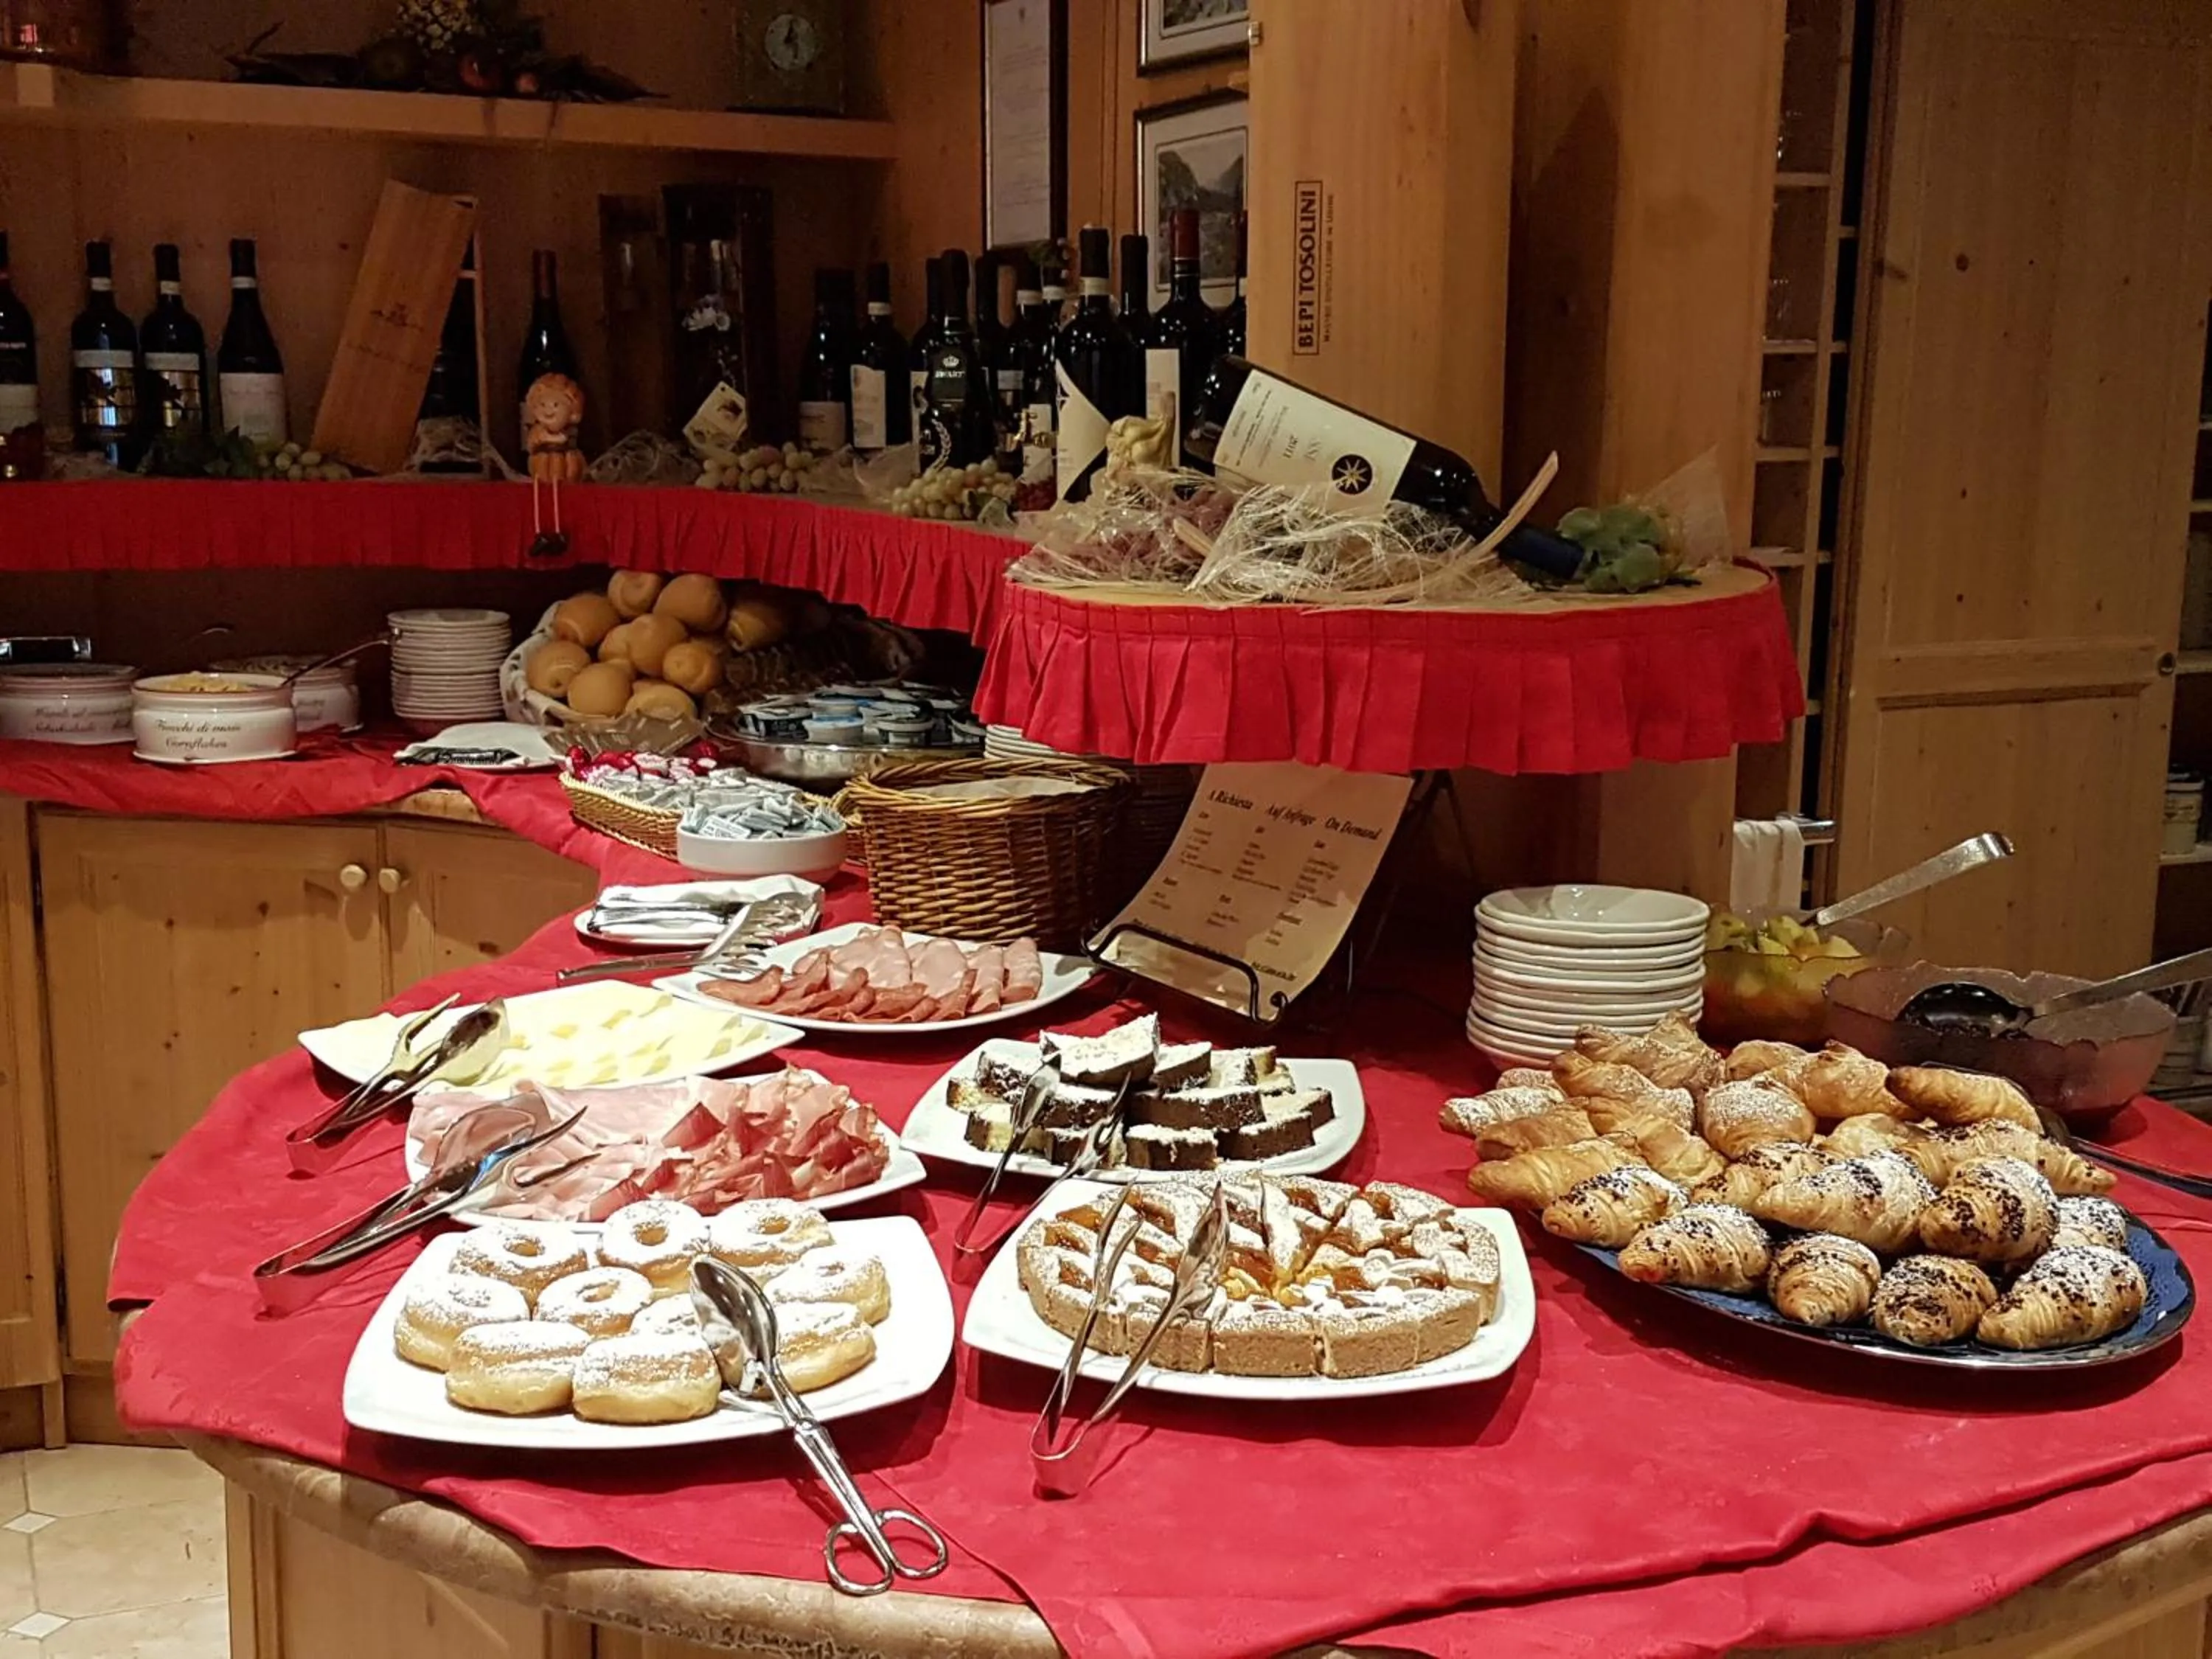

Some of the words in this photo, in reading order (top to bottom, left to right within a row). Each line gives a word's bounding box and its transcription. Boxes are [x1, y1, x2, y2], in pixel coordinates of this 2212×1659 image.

[1298, 189, 1317, 295] TOSOLINI
[1297, 300, 1315, 349] BEPI
[1215, 790, 1253, 810] Richiesta
[1324, 817, 1340, 831] On
[1340, 821, 1382, 841] Demand
